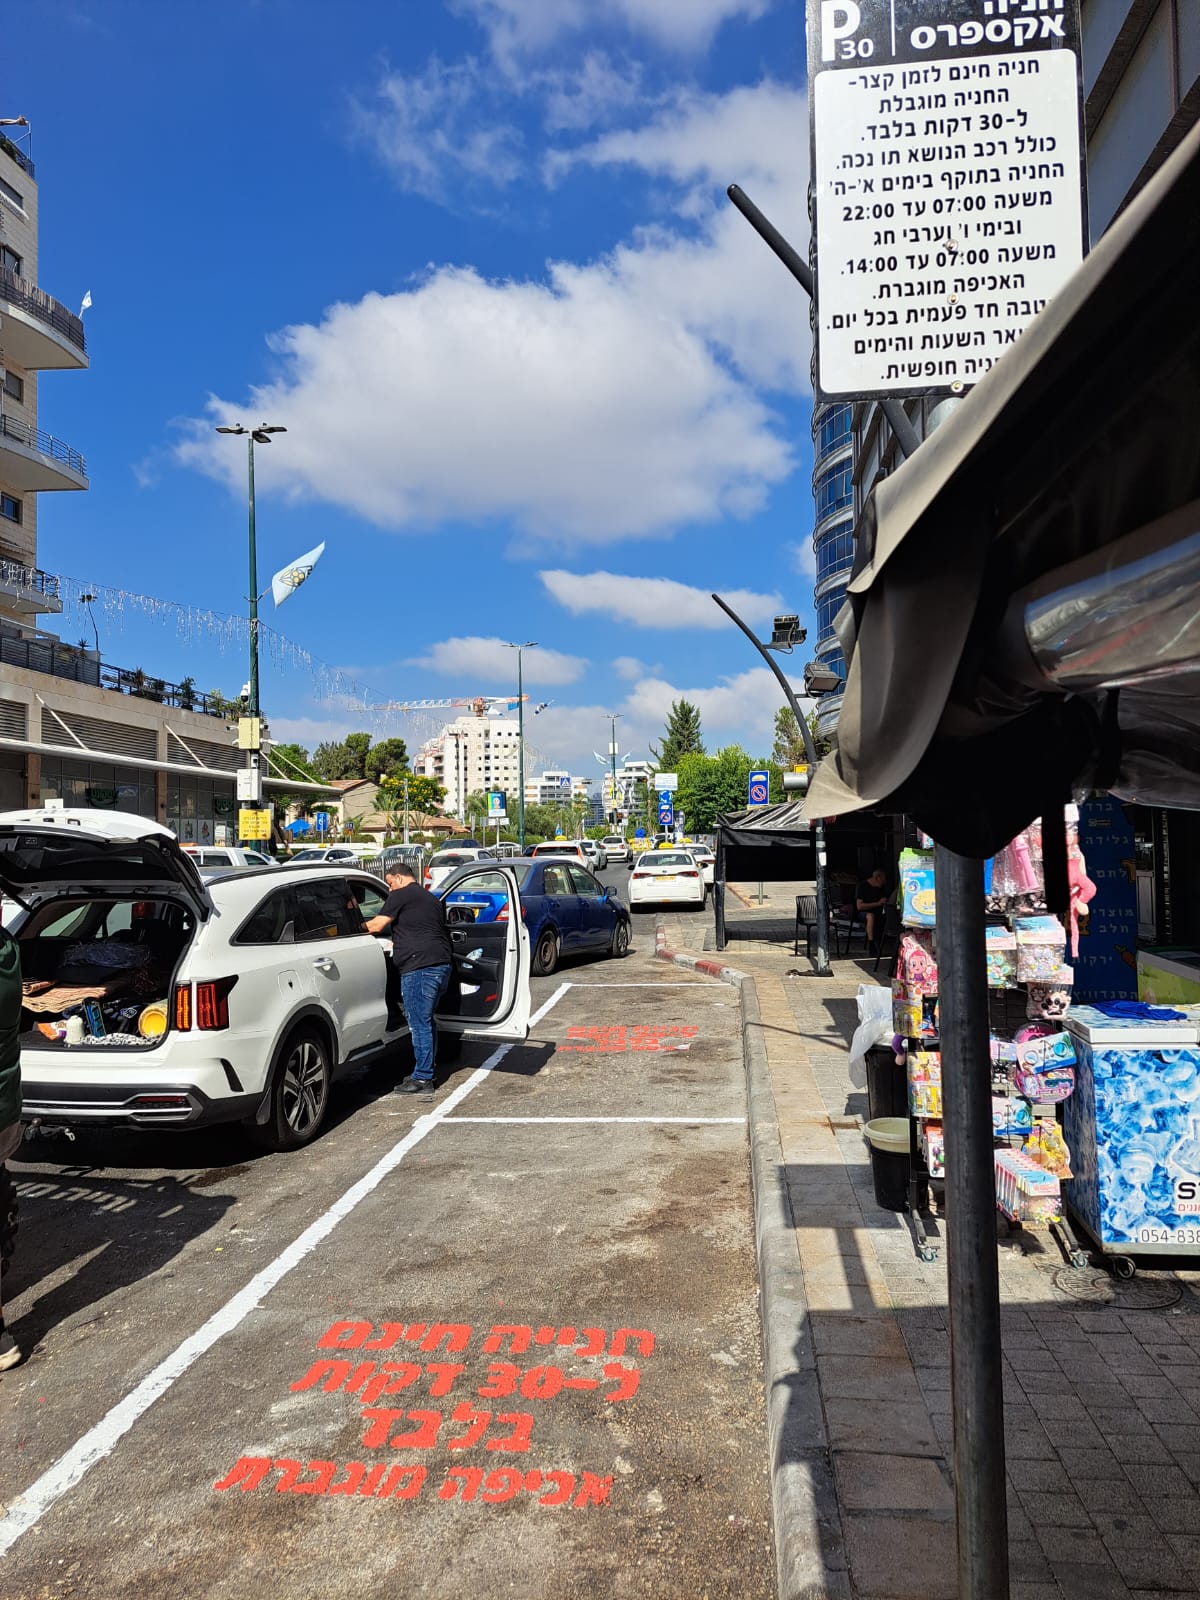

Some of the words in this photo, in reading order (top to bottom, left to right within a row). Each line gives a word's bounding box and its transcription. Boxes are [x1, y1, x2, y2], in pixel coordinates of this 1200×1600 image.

[821, 0, 861, 62] P
[910, 14, 1066, 50] אקספרס
[840, 38, 874, 60] 30
[902, 65, 941, 90] לזמן
[949, 63, 990, 81] חינם
[998, 59, 1040, 77] חניה
[879, 93, 947, 114] מוגבלת
[954, 88, 1010, 107] החניה
[861, 120, 917, 141] בלבד.
[923, 116, 972, 138] דקות
[908, 144, 966, 163] הנושא
[973, 140, 1008, 158] רכב
[1014, 135, 1057, 154] כולל
[836, 153, 874, 170] נכה.
[881, 150, 901, 166] תו
[882, 173, 934, 192] בימים
[940, 167, 1001, 191] בתוקף
[1008, 162, 1064, 183] החניה
[902, 200, 926, 217] עד
[932, 195, 986, 214] 07:00
[994, 190, 1053, 210] משעה
[842, 202, 895, 222] 22:00
[873, 230, 895, 247] חג
[902, 225, 952, 244] וערבי
[976, 219, 1022, 238] ובימי
[905, 253, 929, 272] עד
[935, 249, 990, 269] 07:00
[997, 244, 1056, 264] משעה
[840, 255, 898, 277] 14:00.
[872, 279, 946, 300] מוגברת.
[953, 273, 1025, 294] האכיפה
[863, 308, 899, 328] בכל
[905, 304, 967, 327] פעמית
[973, 302, 999, 320] חד
[826, 313, 858, 331] יום.
[854, 335, 914, 355] והימים
[920, 331, 986, 351] השעות
[992, 328, 1022, 346] אר
[880, 360, 957, 381] חופשית.
[964, 357, 999, 375] ניה
[317, 1320, 473, 1352] חינם
[481, 1324, 655, 1358] חנייה
[289, 1359, 465, 1403] דקות
[360, 1402, 535, 1452] בלבד
[213, 1456, 428, 1500] מוגברת
[437, 1465, 614, 1508] אכיפה
